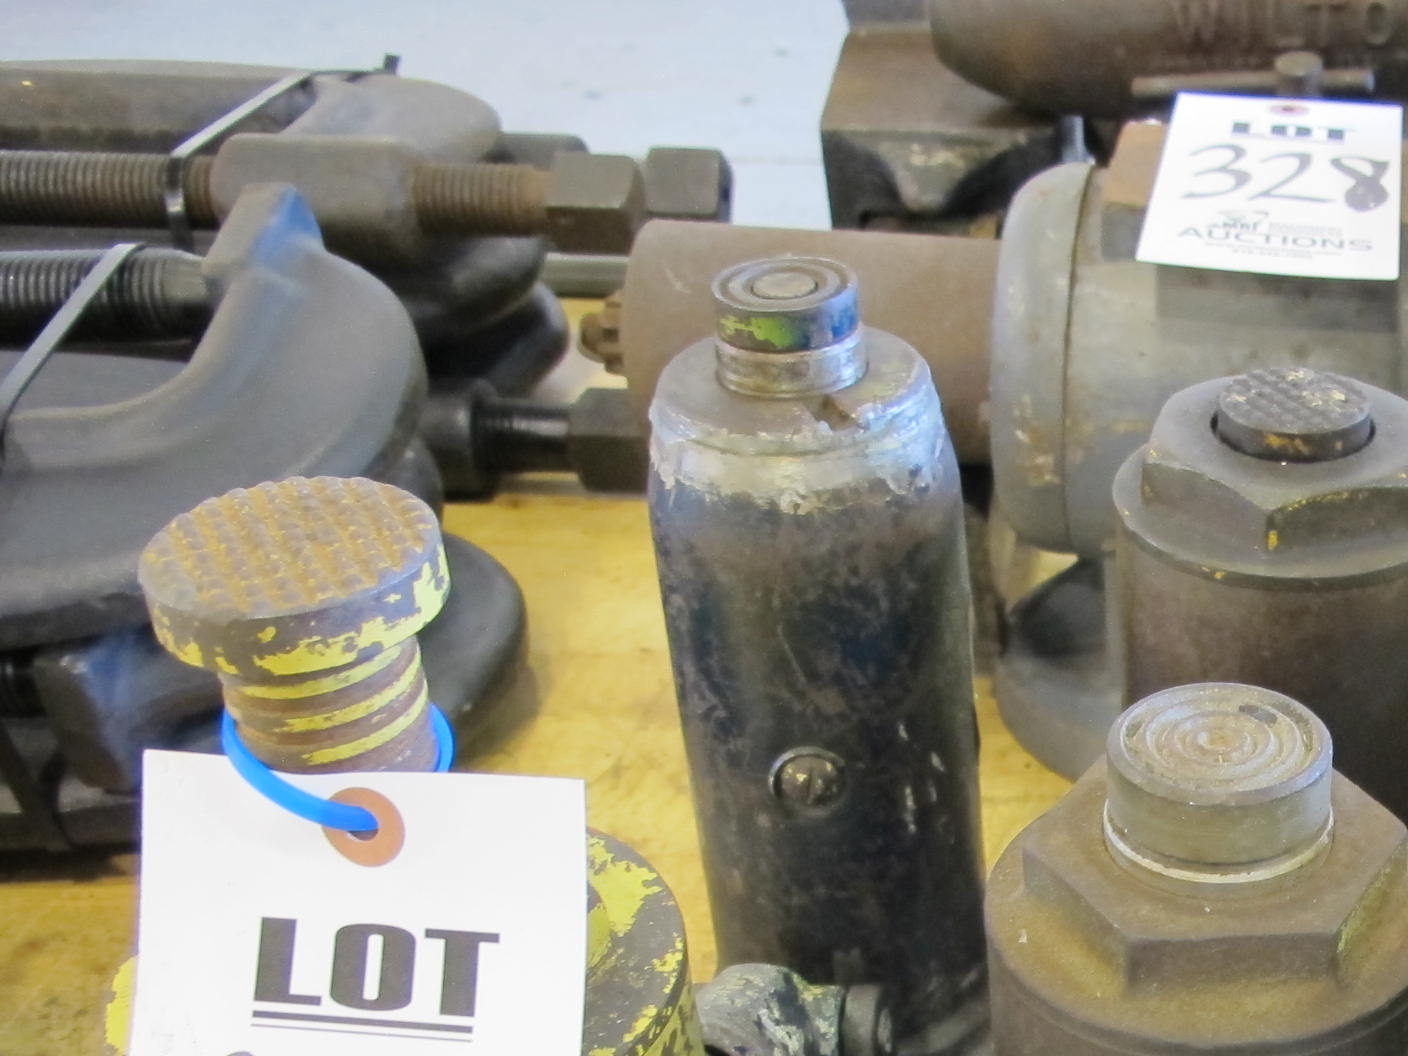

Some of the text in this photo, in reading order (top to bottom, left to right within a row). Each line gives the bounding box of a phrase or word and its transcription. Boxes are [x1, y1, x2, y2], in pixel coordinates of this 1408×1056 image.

[1181, 144, 1390, 212] 328
[1177, 226, 1374, 251] AUCTIONS
[253, 917, 500, 1018] LOT
